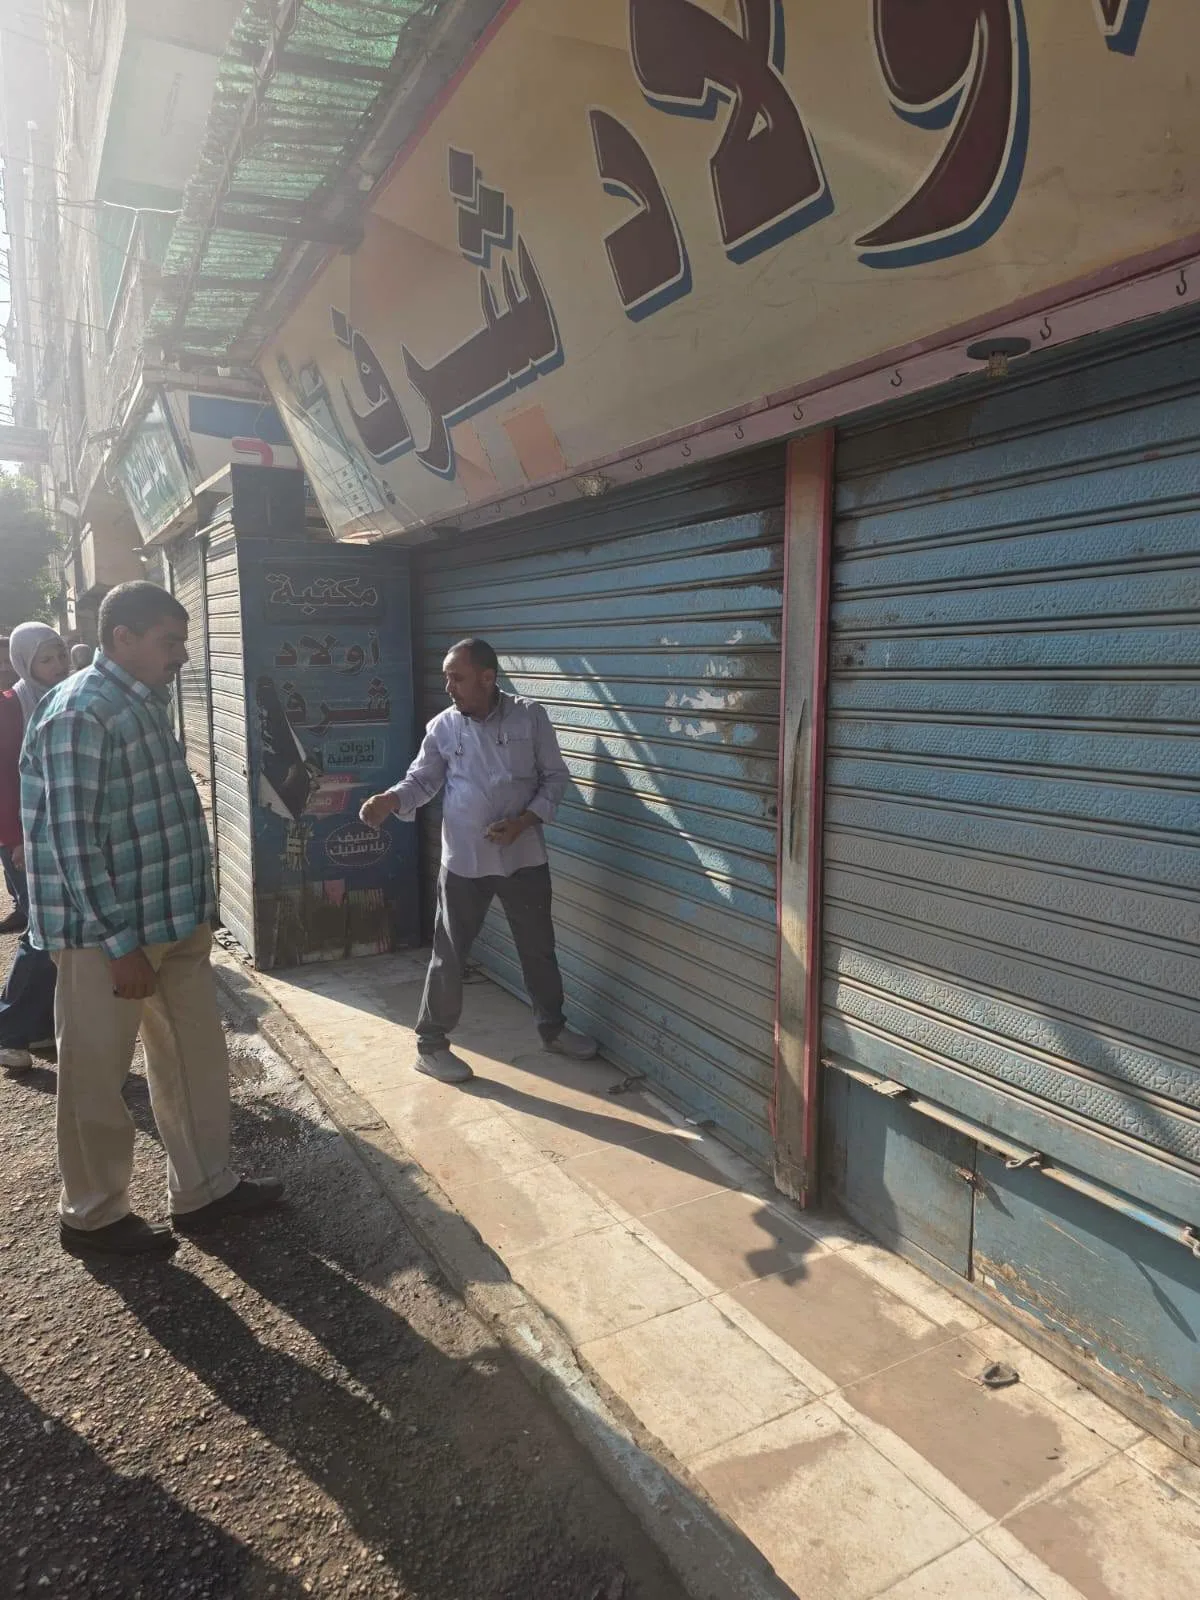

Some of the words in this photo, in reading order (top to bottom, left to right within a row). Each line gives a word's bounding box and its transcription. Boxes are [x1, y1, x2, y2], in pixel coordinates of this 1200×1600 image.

[588, 0, 1147, 322] ولاد
[331, 146, 564, 478] شرف
[265, 573, 378, 615] مكتبة
[273, 628, 380, 677] أولاد
[281, 676, 391, 737] شرف
[327, 751, 375, 765] مدرسية
[339, 739, 375, 753] أدوات
[329, 841, 386, 857] بلاستيك
[336, 828, 381, 842] تغليف
